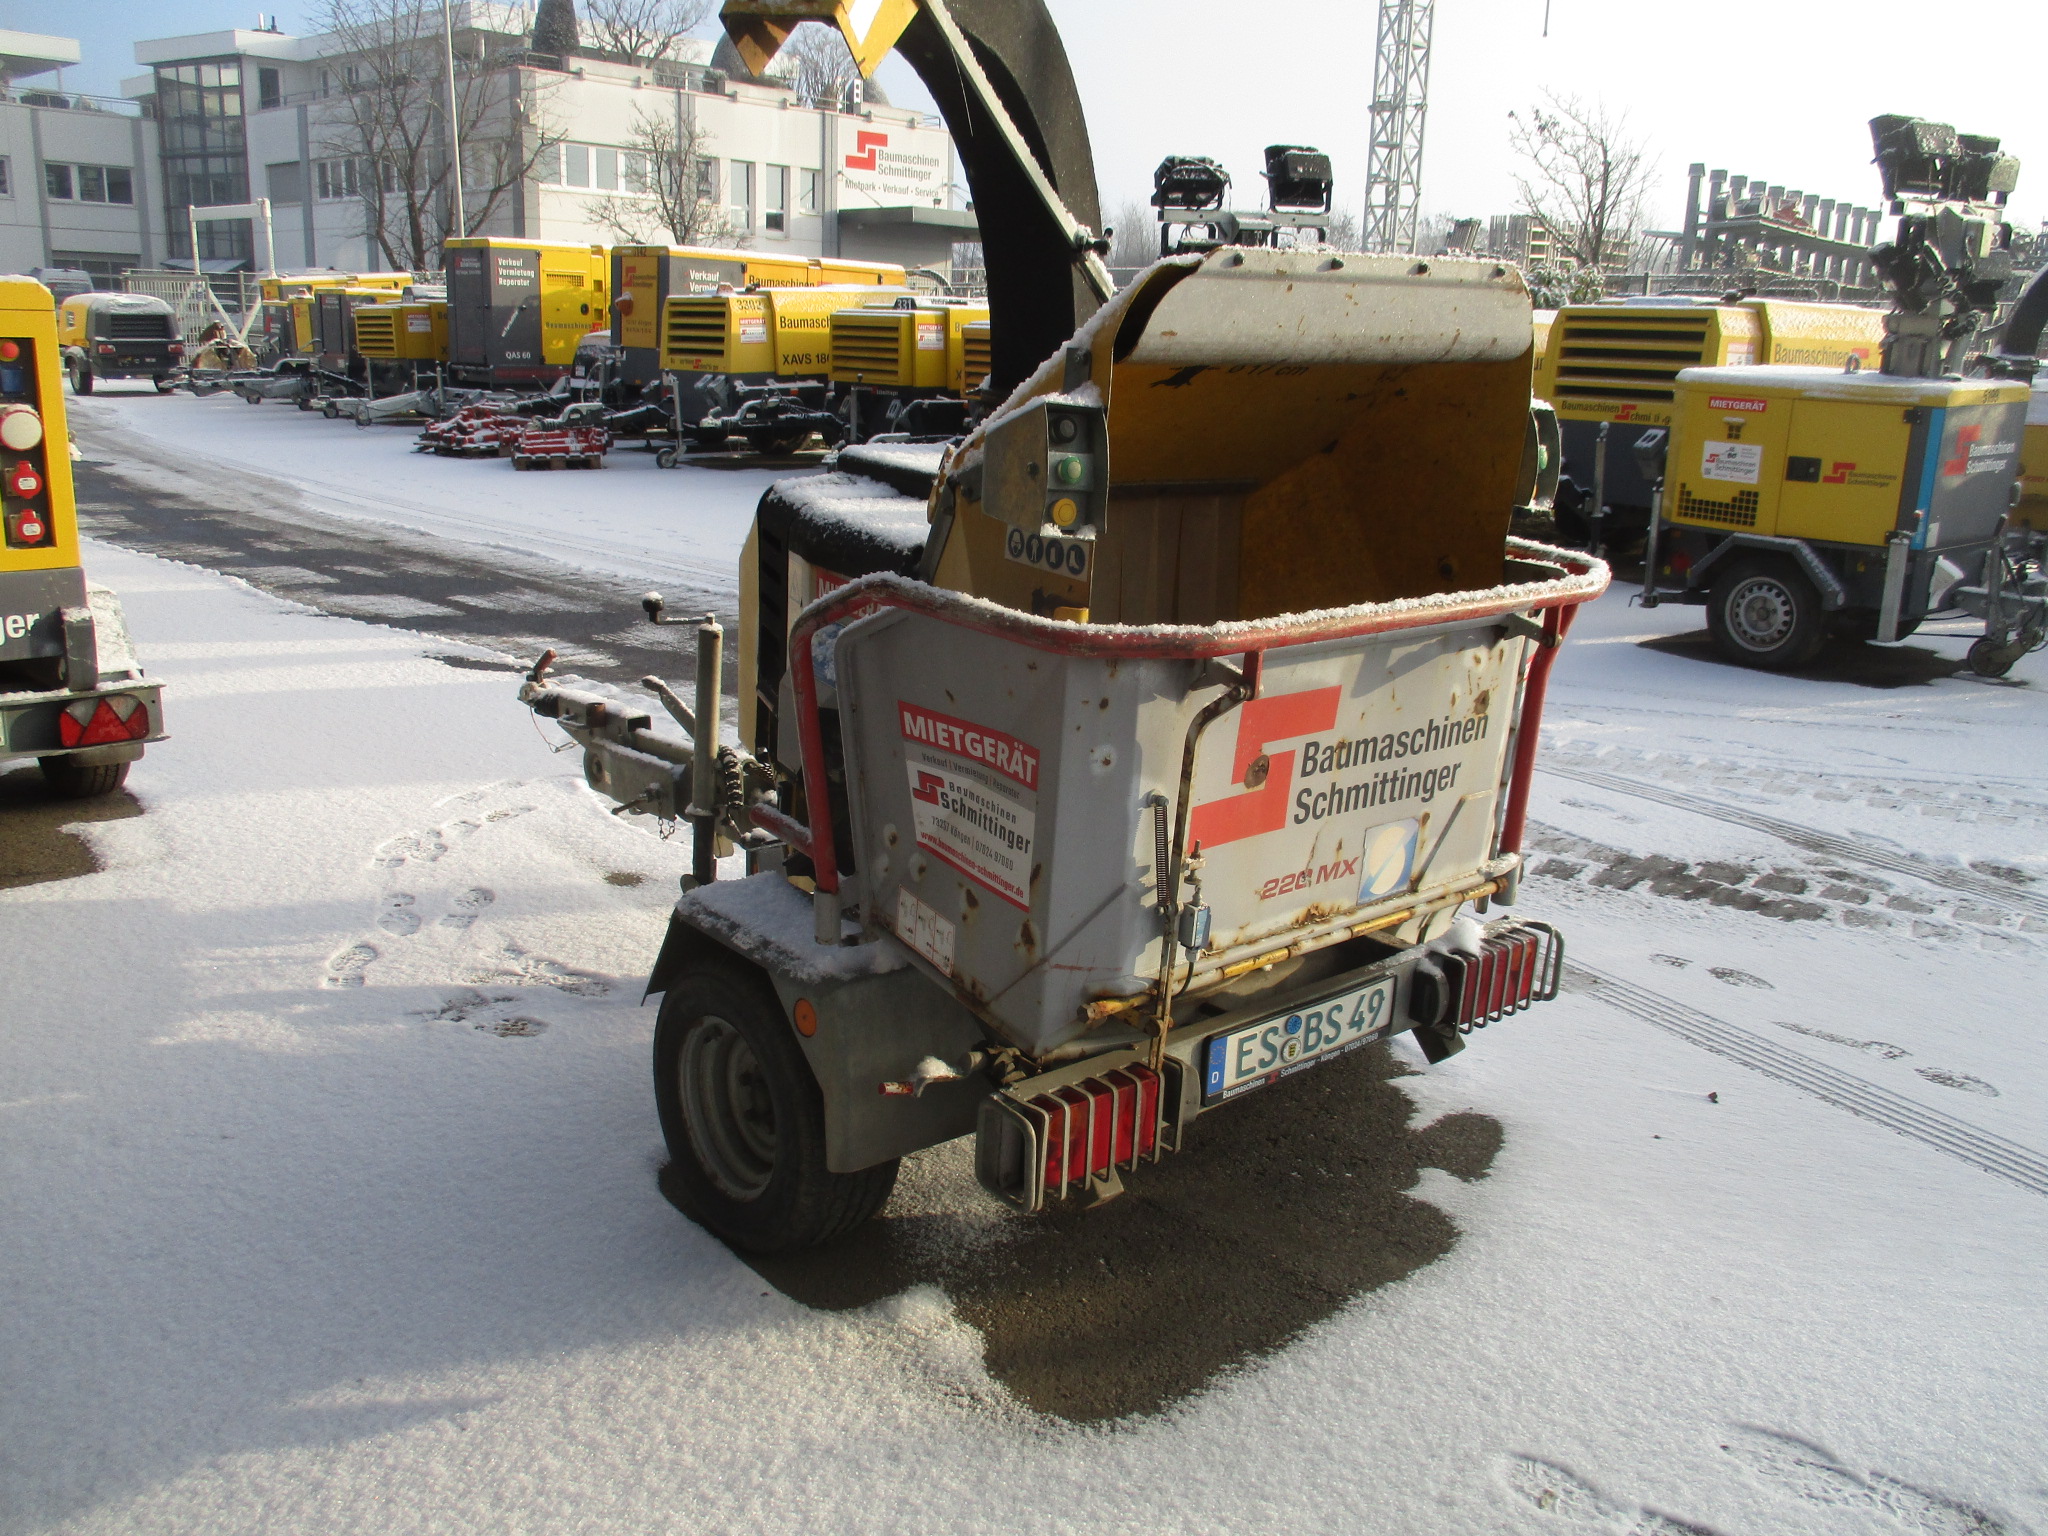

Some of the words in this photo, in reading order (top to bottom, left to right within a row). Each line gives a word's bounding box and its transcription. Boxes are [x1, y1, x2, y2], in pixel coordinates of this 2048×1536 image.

[878, 149, 940, 168] Baumaschinen
[878, 164, 932, 182] Schmittinger
[845, 179, 877, 192] Mietpark
[883, 183, 909, 196] Verkauf
[915, 187, 939, 198] Service
[498, 257, 523, 267] Verkauf
[498, 267, 535, 278] Vermietung
[690, 270, 720, 282] Verkauf
[506, 351, 521, 360] QAS
[522, 351, 531, 359] 60
[783, 353, 812, 365] XAVS
[1561, 401, 1620, 413] Baumaschinen
[1710, 398, 1766, 412] MIETGERÄT
[1969, 441, 2016, 458] Baumaschinen
[1966, 458, 2008, 474] Schmittinger
[903, 711, 1037, 784] MIETGERÄT
[1300, 714, 1489, 778] Baumaschinen
[921, 752, 948, 767] Verkauf
[1293, 761, 1462, 825] Schmittinger
[949, 781, 1017, 825] Baumaschinen
[940, 791, 1031, 854] Schmittinger
[920, 832, 1024, 899] www.baumaschinen-schmittinger.de
[1315, 856, 1360, 885] MX
[1211, 1071, 1219, 1084] D
[1235, 1026, 1280, 1079] ES
[1303, 1003, 1343, 1054] BS
[1348, 988, 1385, 1033] 49
[1222, 1077, 1266, 1099] Baumaschinen
[1280, 1059, 1316, 1078] Schmittinger
